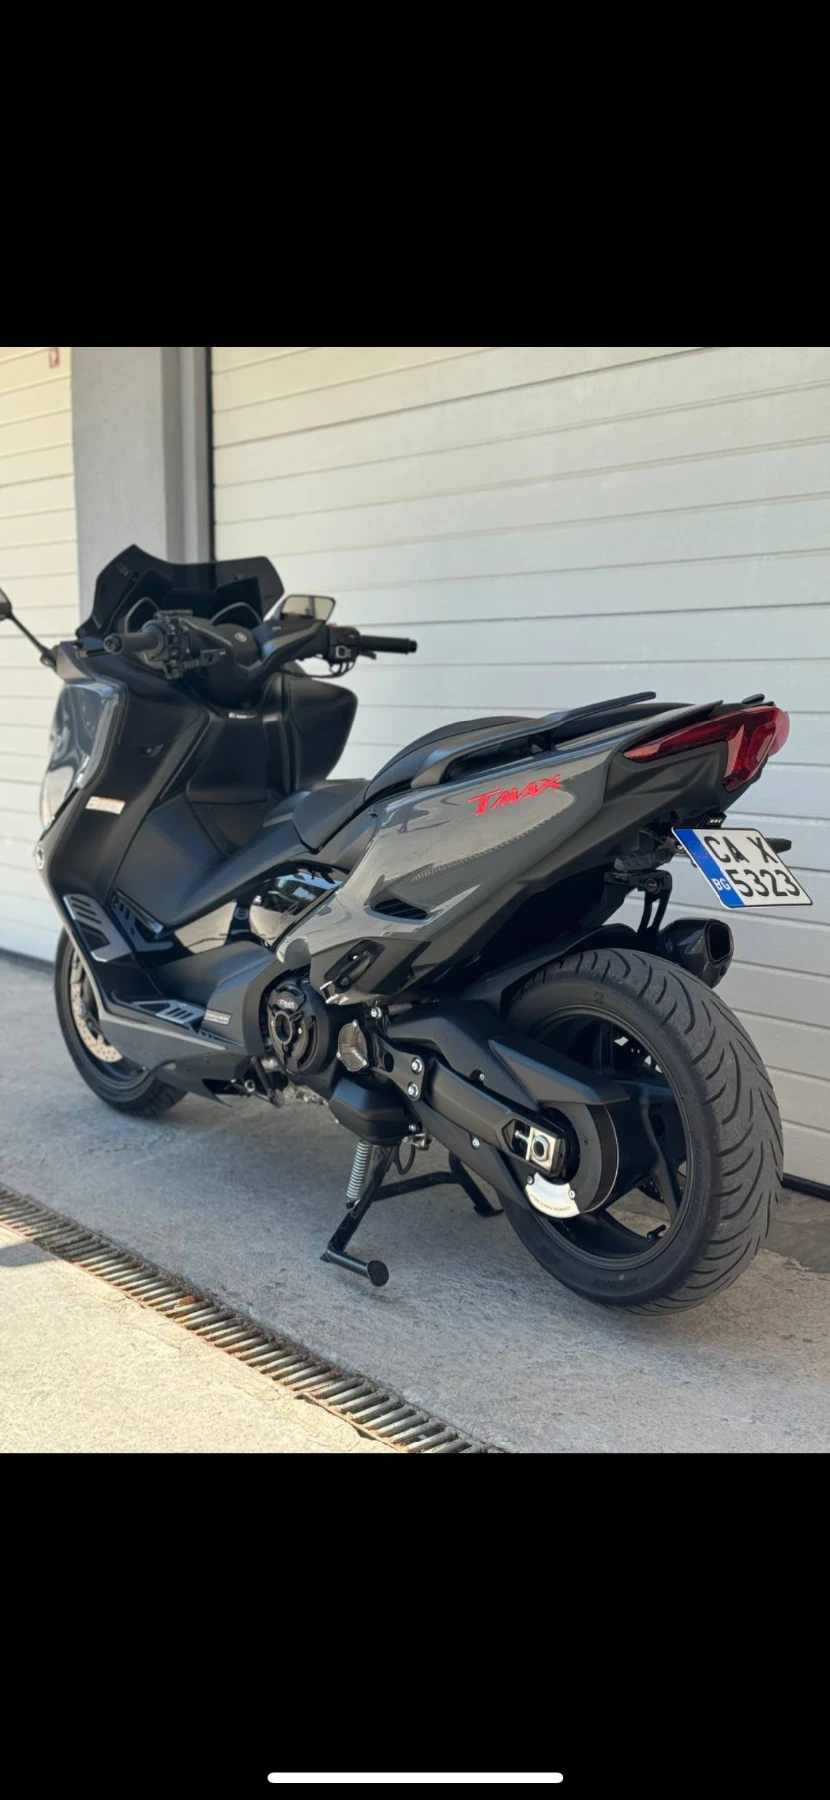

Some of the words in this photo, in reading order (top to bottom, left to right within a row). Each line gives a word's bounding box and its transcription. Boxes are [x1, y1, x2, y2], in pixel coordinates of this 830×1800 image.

[468, 773, 563, 816] TMAX
[704, 836, 750, 863] CA
[746, 836, 779, 863] X
[711, 878, 731, 891] BG
[725, 869, 800, 897] 5323
